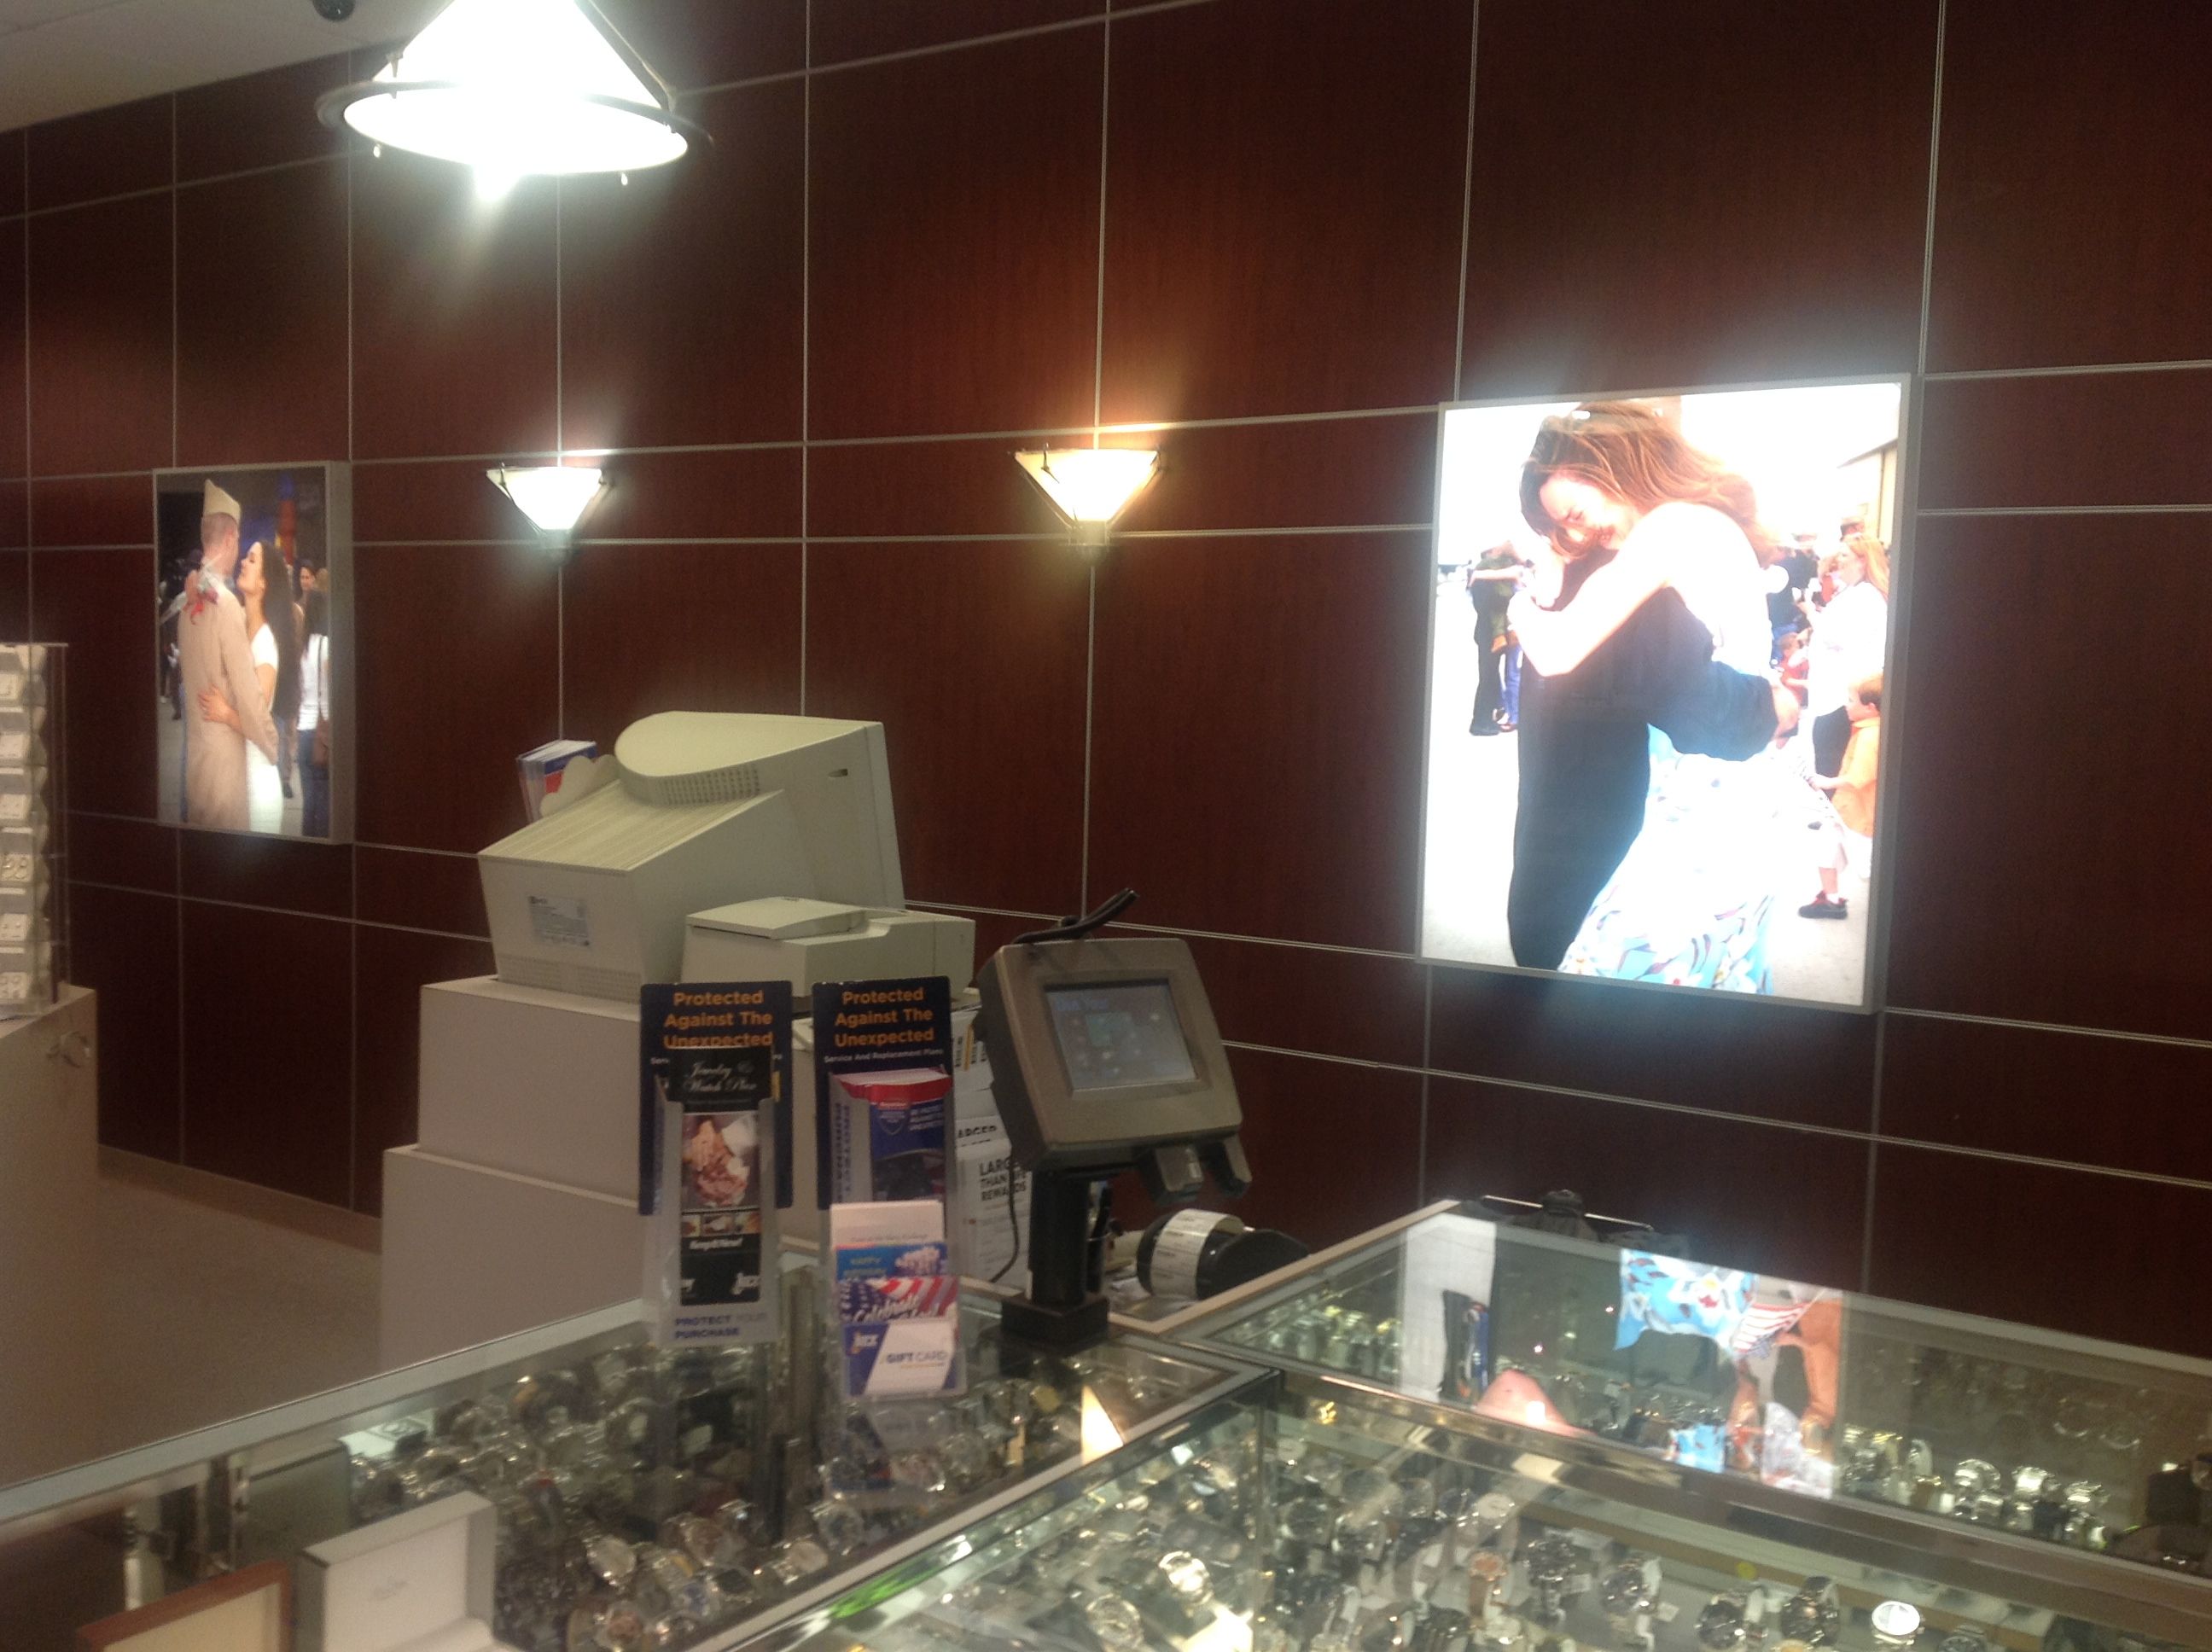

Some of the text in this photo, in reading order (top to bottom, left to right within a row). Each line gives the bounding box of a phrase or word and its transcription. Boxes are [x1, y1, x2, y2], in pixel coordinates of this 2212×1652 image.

[673, 990, 765, 1007] Protected
[842, 986, 924, 1005] Protected
[664, 1009, 773, 1030] Against The
[835, 1007, 934, 1029] Against The
[664, 1031, 774, 1050] Unexpected
[835, 1027, 935, 1047] Unexpected
[674, 1327, 741, 1339] PURCHASE
[887, 1350, 947, 1364] GIFT CARD
